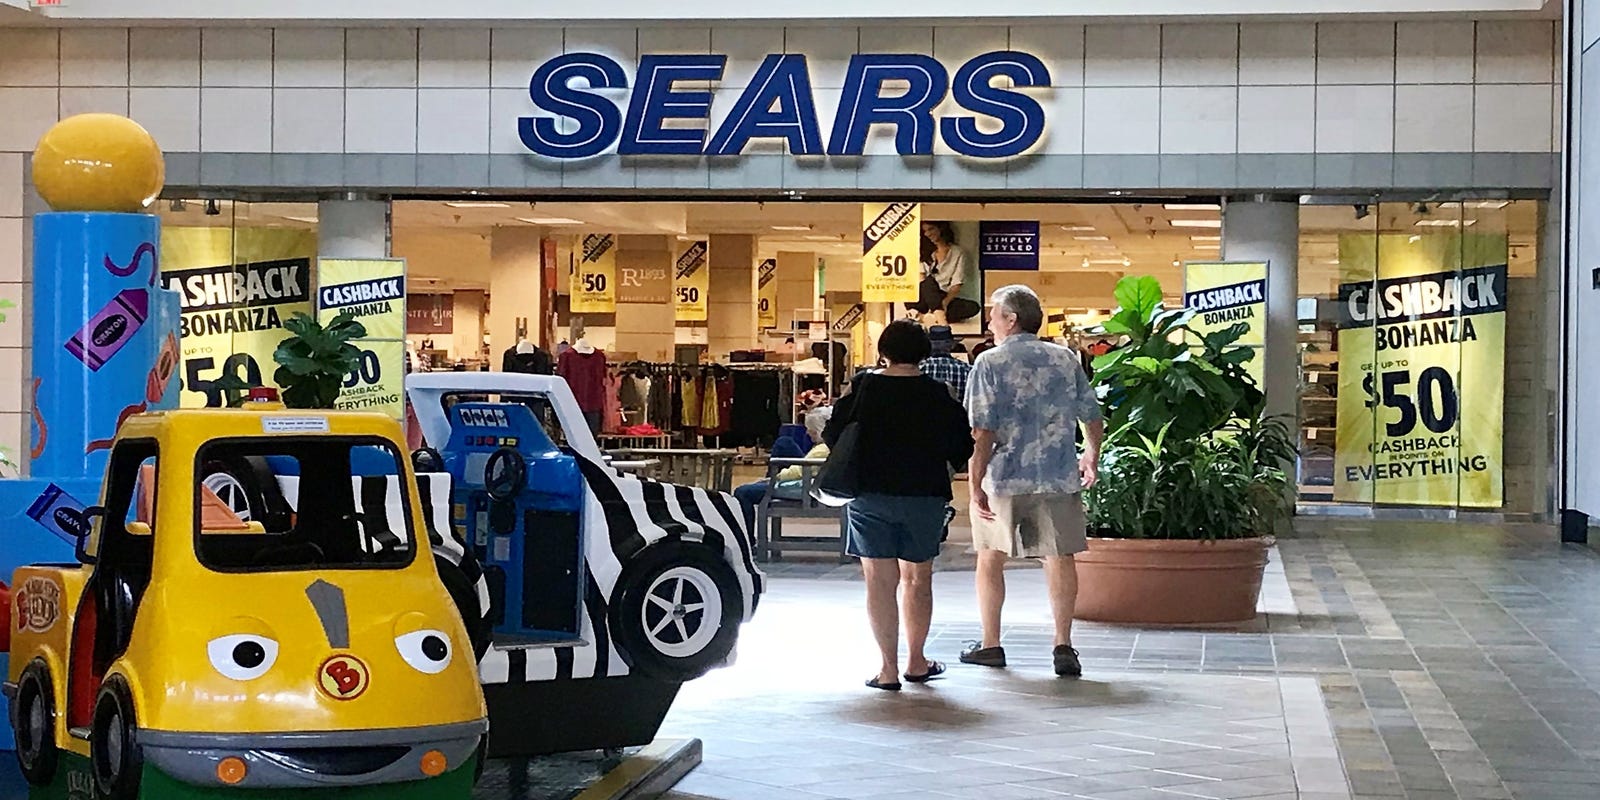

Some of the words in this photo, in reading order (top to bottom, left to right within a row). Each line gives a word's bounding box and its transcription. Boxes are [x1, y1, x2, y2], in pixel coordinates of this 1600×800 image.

[518, 51, 1052, 158] SEARS
[866, 202, 914, 241] CASHBAC
[887, 213, 916, 241] BONANZA
[876, 255, 907, 277] $50
[160, 266, 302, 309] ASHBACK
[323, 279, 400, 306] CASHBACK
[676, 287, 699, 303] $50
[1189, 282, 1263, 311] CASHBACK
[1348, 273, 1499, 321] CASHBACK
[180, 307, 282, 338] BONANZA
[339, 301, 392, 317] BONANZA
[1204, 306, 1255, 325] BONANZA
[94, 316, 126, 345] CRAYON
[1376, 317, 1477, 351] BONANZA
[1381, 361, 1394, 369] UP
[1395, 359, 1408, 367] TO
[180, 353, 262, 408] 50
[340, 384, 385, 397] ASHBACK
[334, 394, 399, 410] ERYTHING
[1362, 366, 1458, 437] $50
[1368, 435, 1461, 455] CASHBACK
[1400, 452, 1429, 460] POINTS
[1345, 455, 1487, 482] EVERYTHING
[326, 660, 361, 695] B
